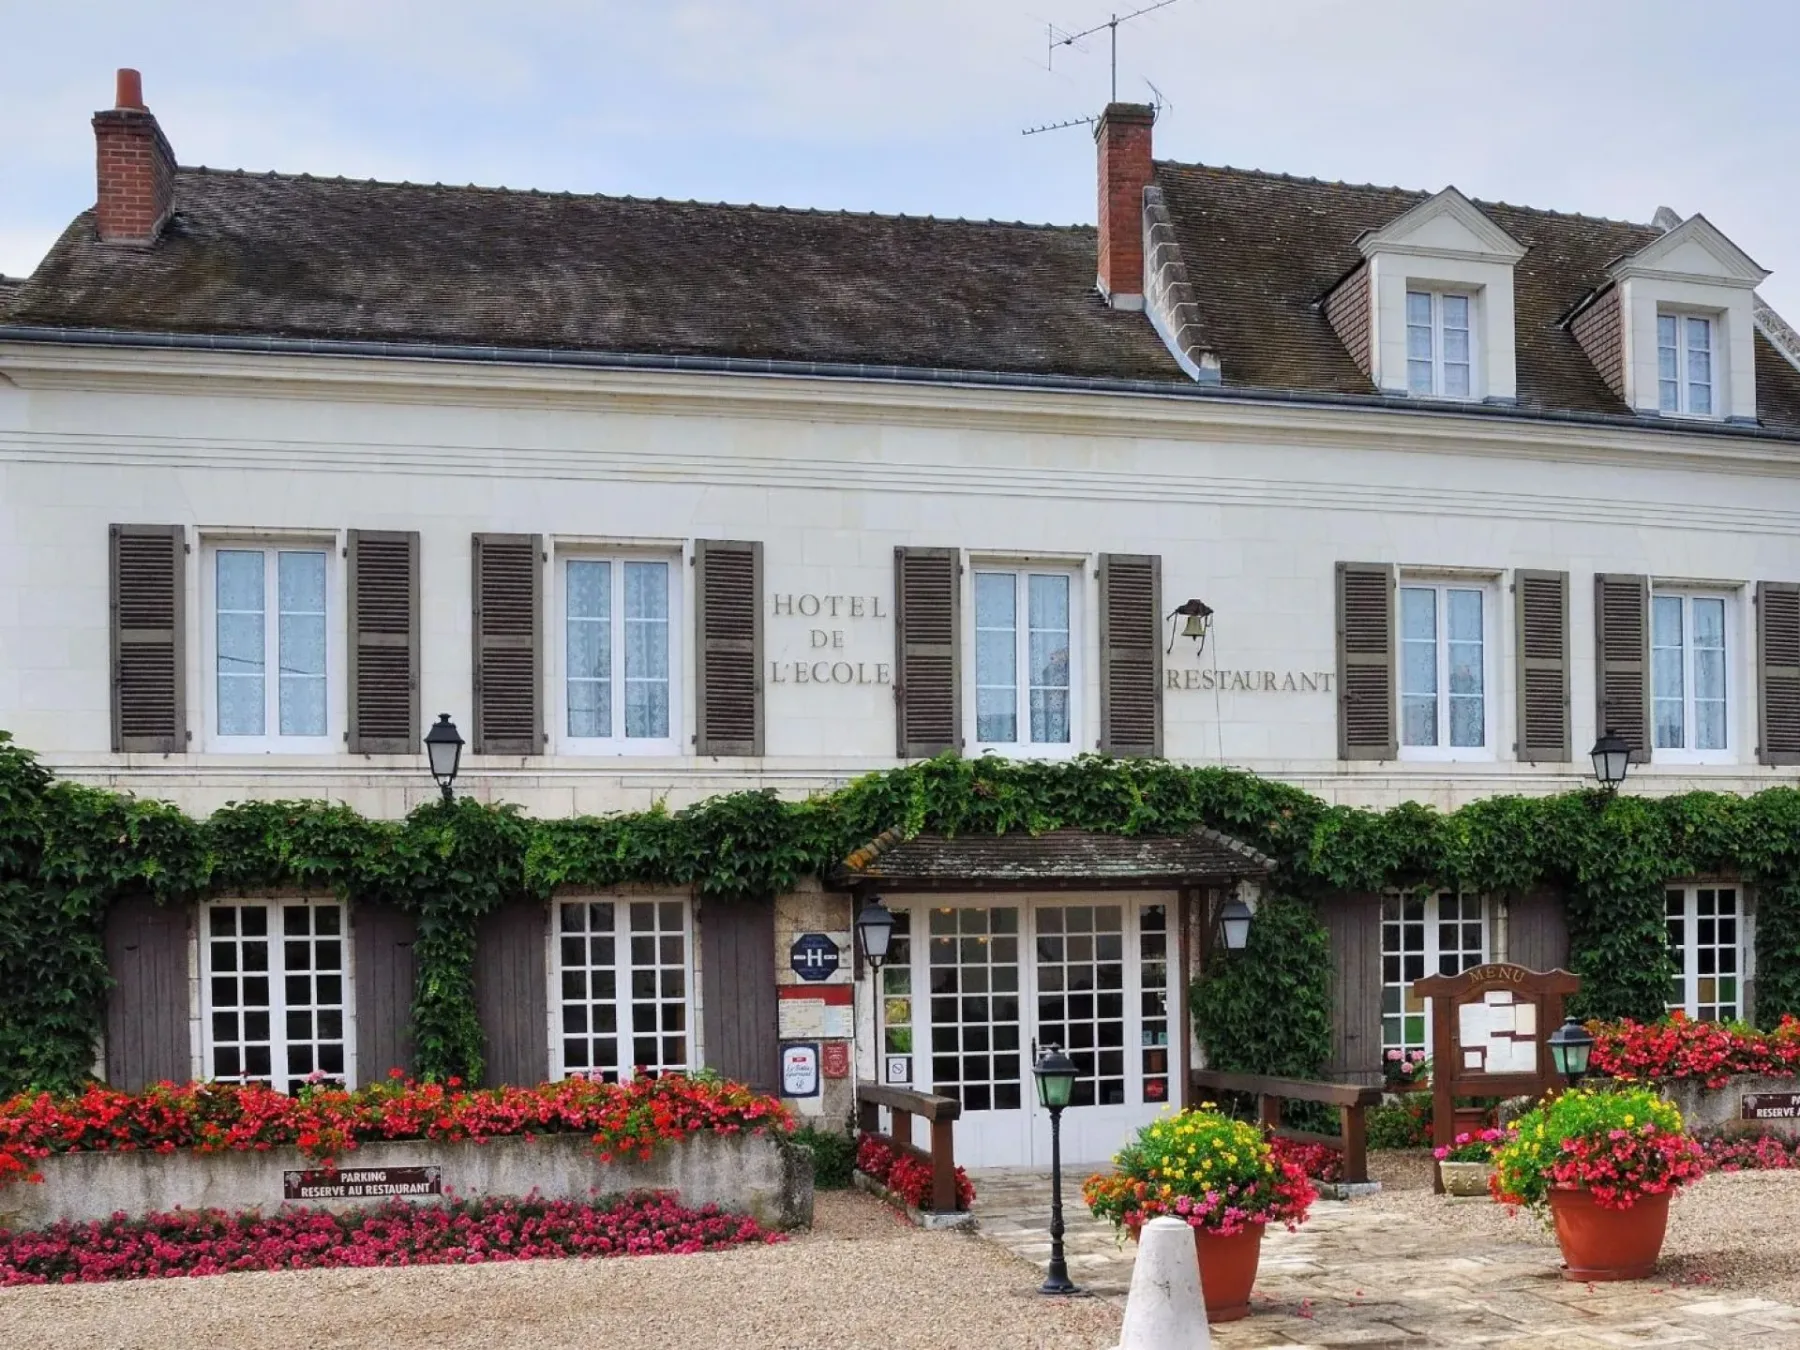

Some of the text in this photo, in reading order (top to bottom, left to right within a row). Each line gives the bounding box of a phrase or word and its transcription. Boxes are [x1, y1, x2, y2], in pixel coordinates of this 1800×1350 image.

[772, 593, 887, 618] HOTEL
[810, 629, 844, 648] DE
[770, 660, 890, 684] L'ECOLE
[1166, 669, 1335, 692] RESTAURANT
[807, 948, 822, 967] H
[1469, 966, 1525, 983] MENU
[1757, 1107, 1794, 1117] RESERVE
[341, 1171, 386, 1182] PARKING
[301, 1183, 430, 1197] RESERVE AU RESTAURANT
